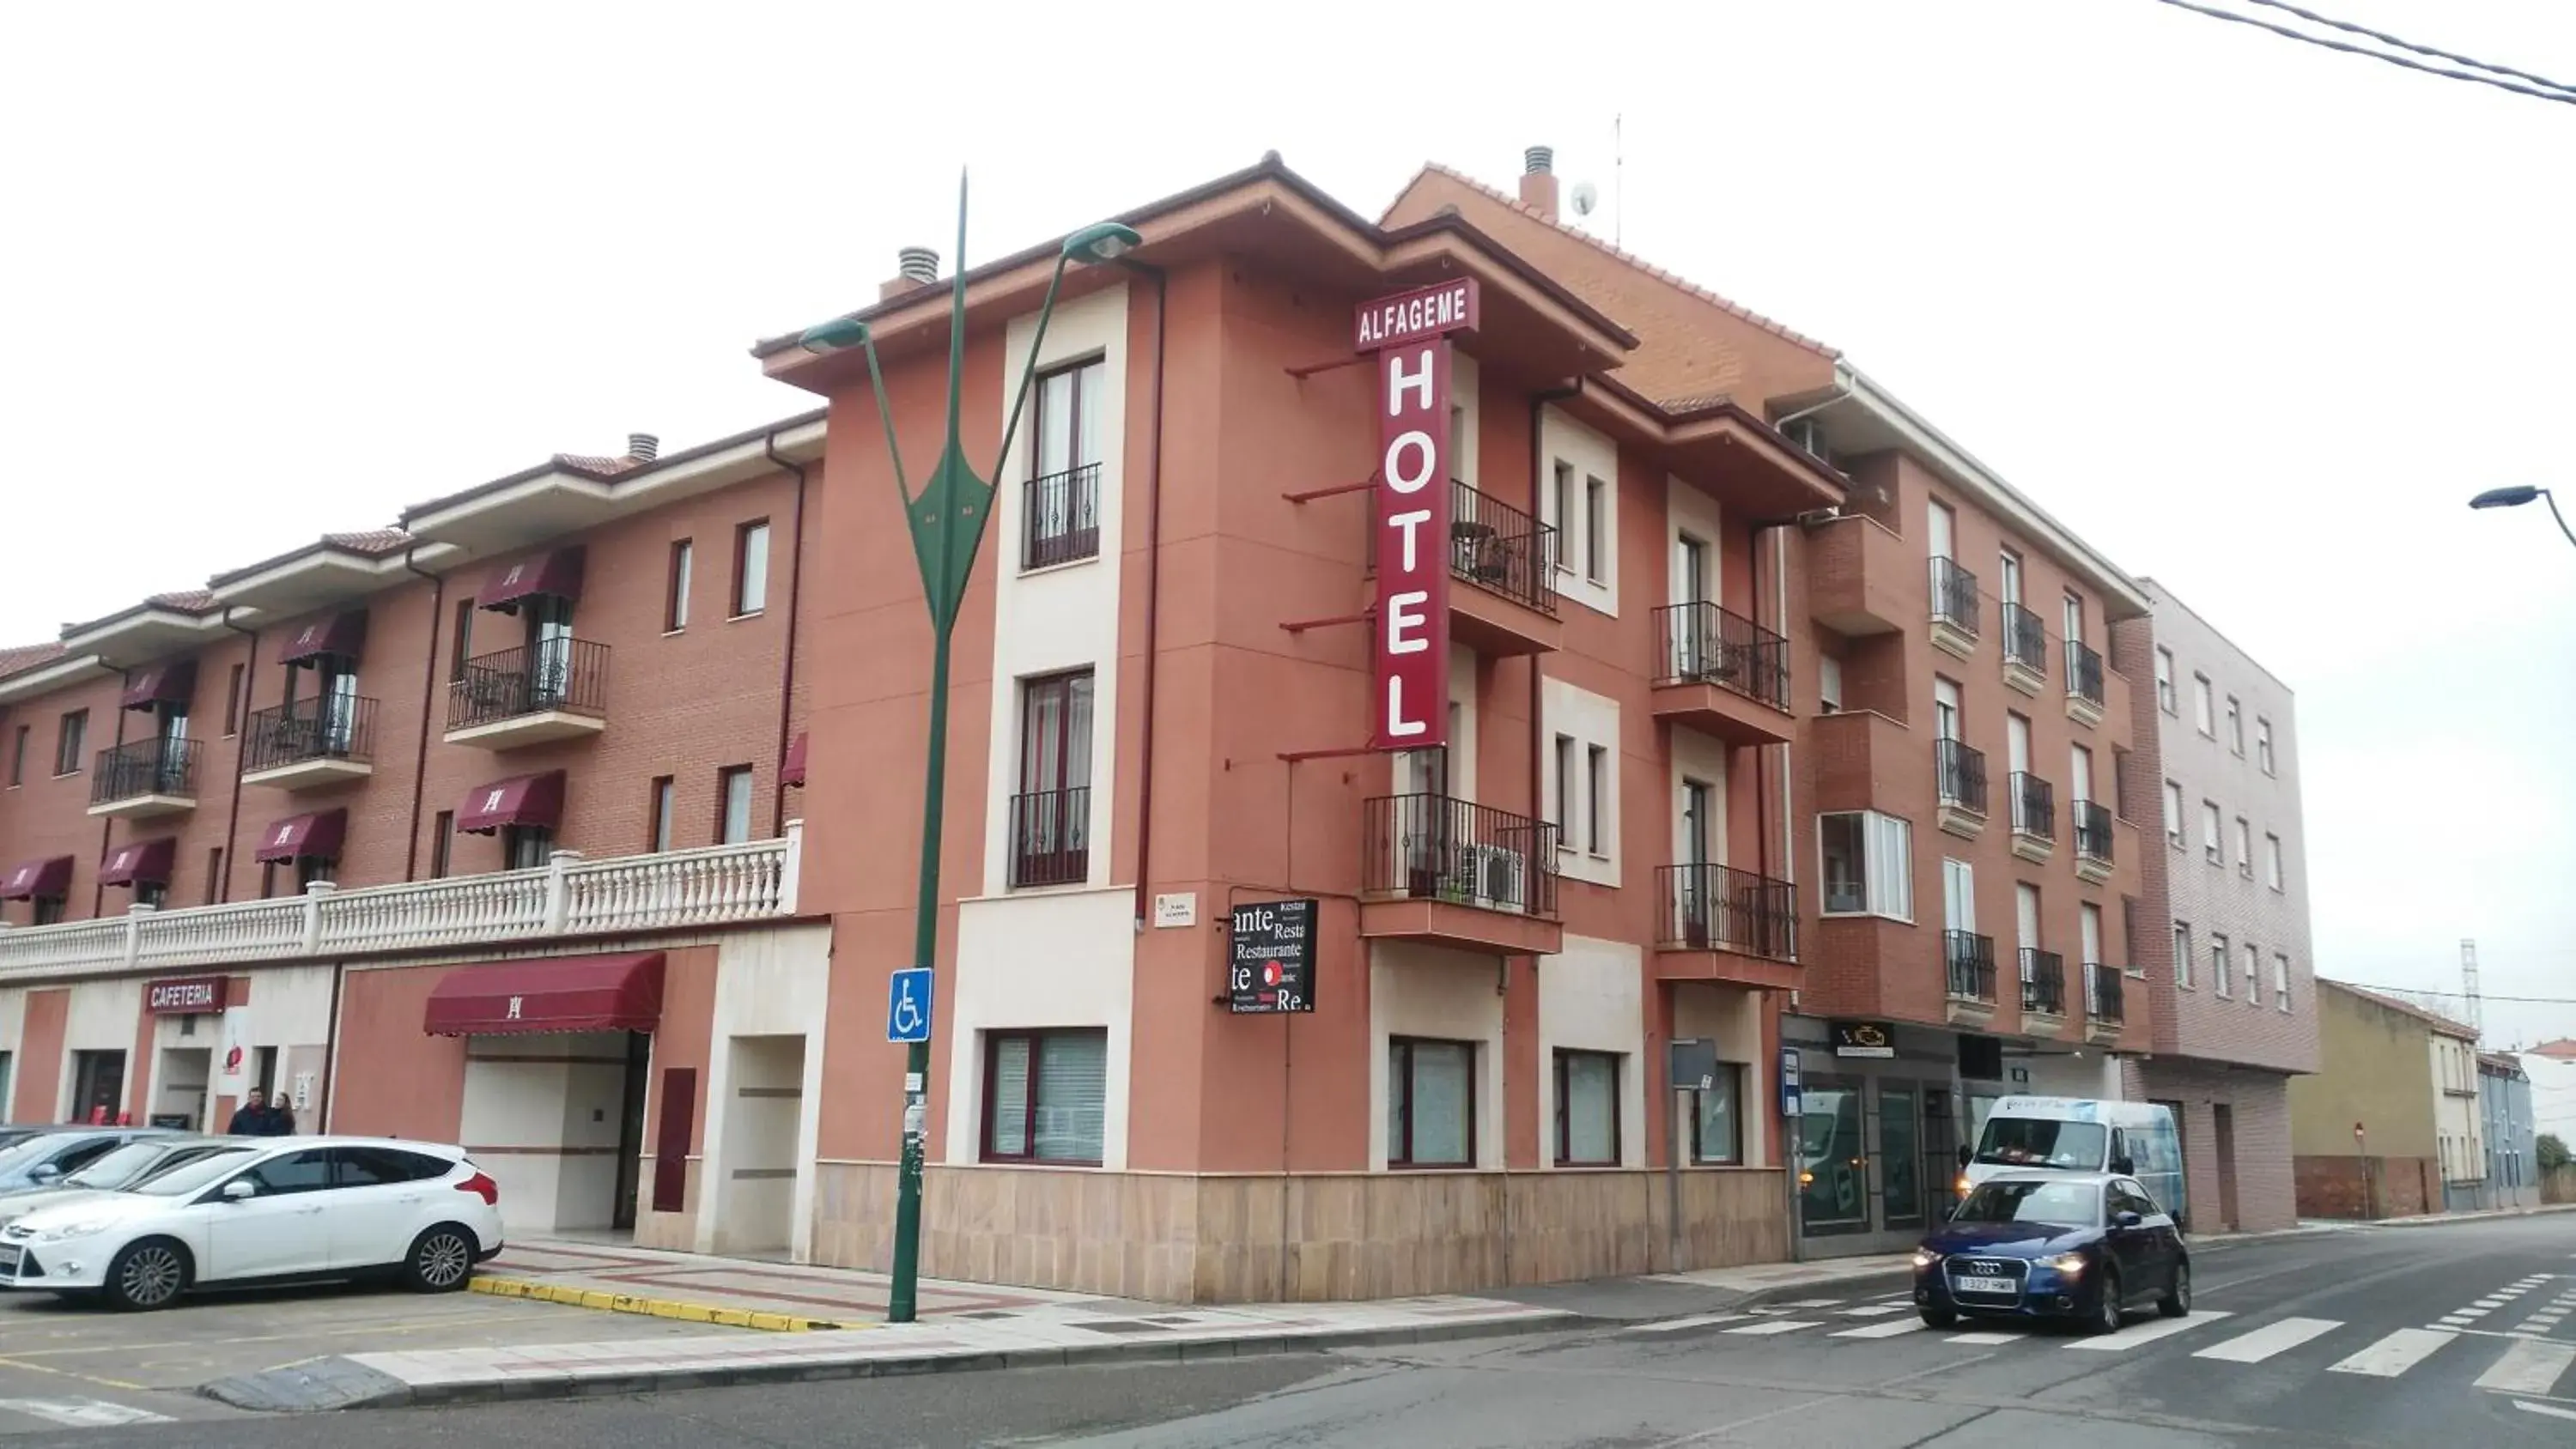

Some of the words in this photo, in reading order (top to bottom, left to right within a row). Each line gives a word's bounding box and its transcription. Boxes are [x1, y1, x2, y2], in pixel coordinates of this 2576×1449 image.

[1359, 288, 1465, 343] ALFAGEME
[1384, 349, 1436, 737] HOTEL
[1236, 943, 1302, 959] Restaurante
[151, 984, 212, 1007] CAFETERIA
